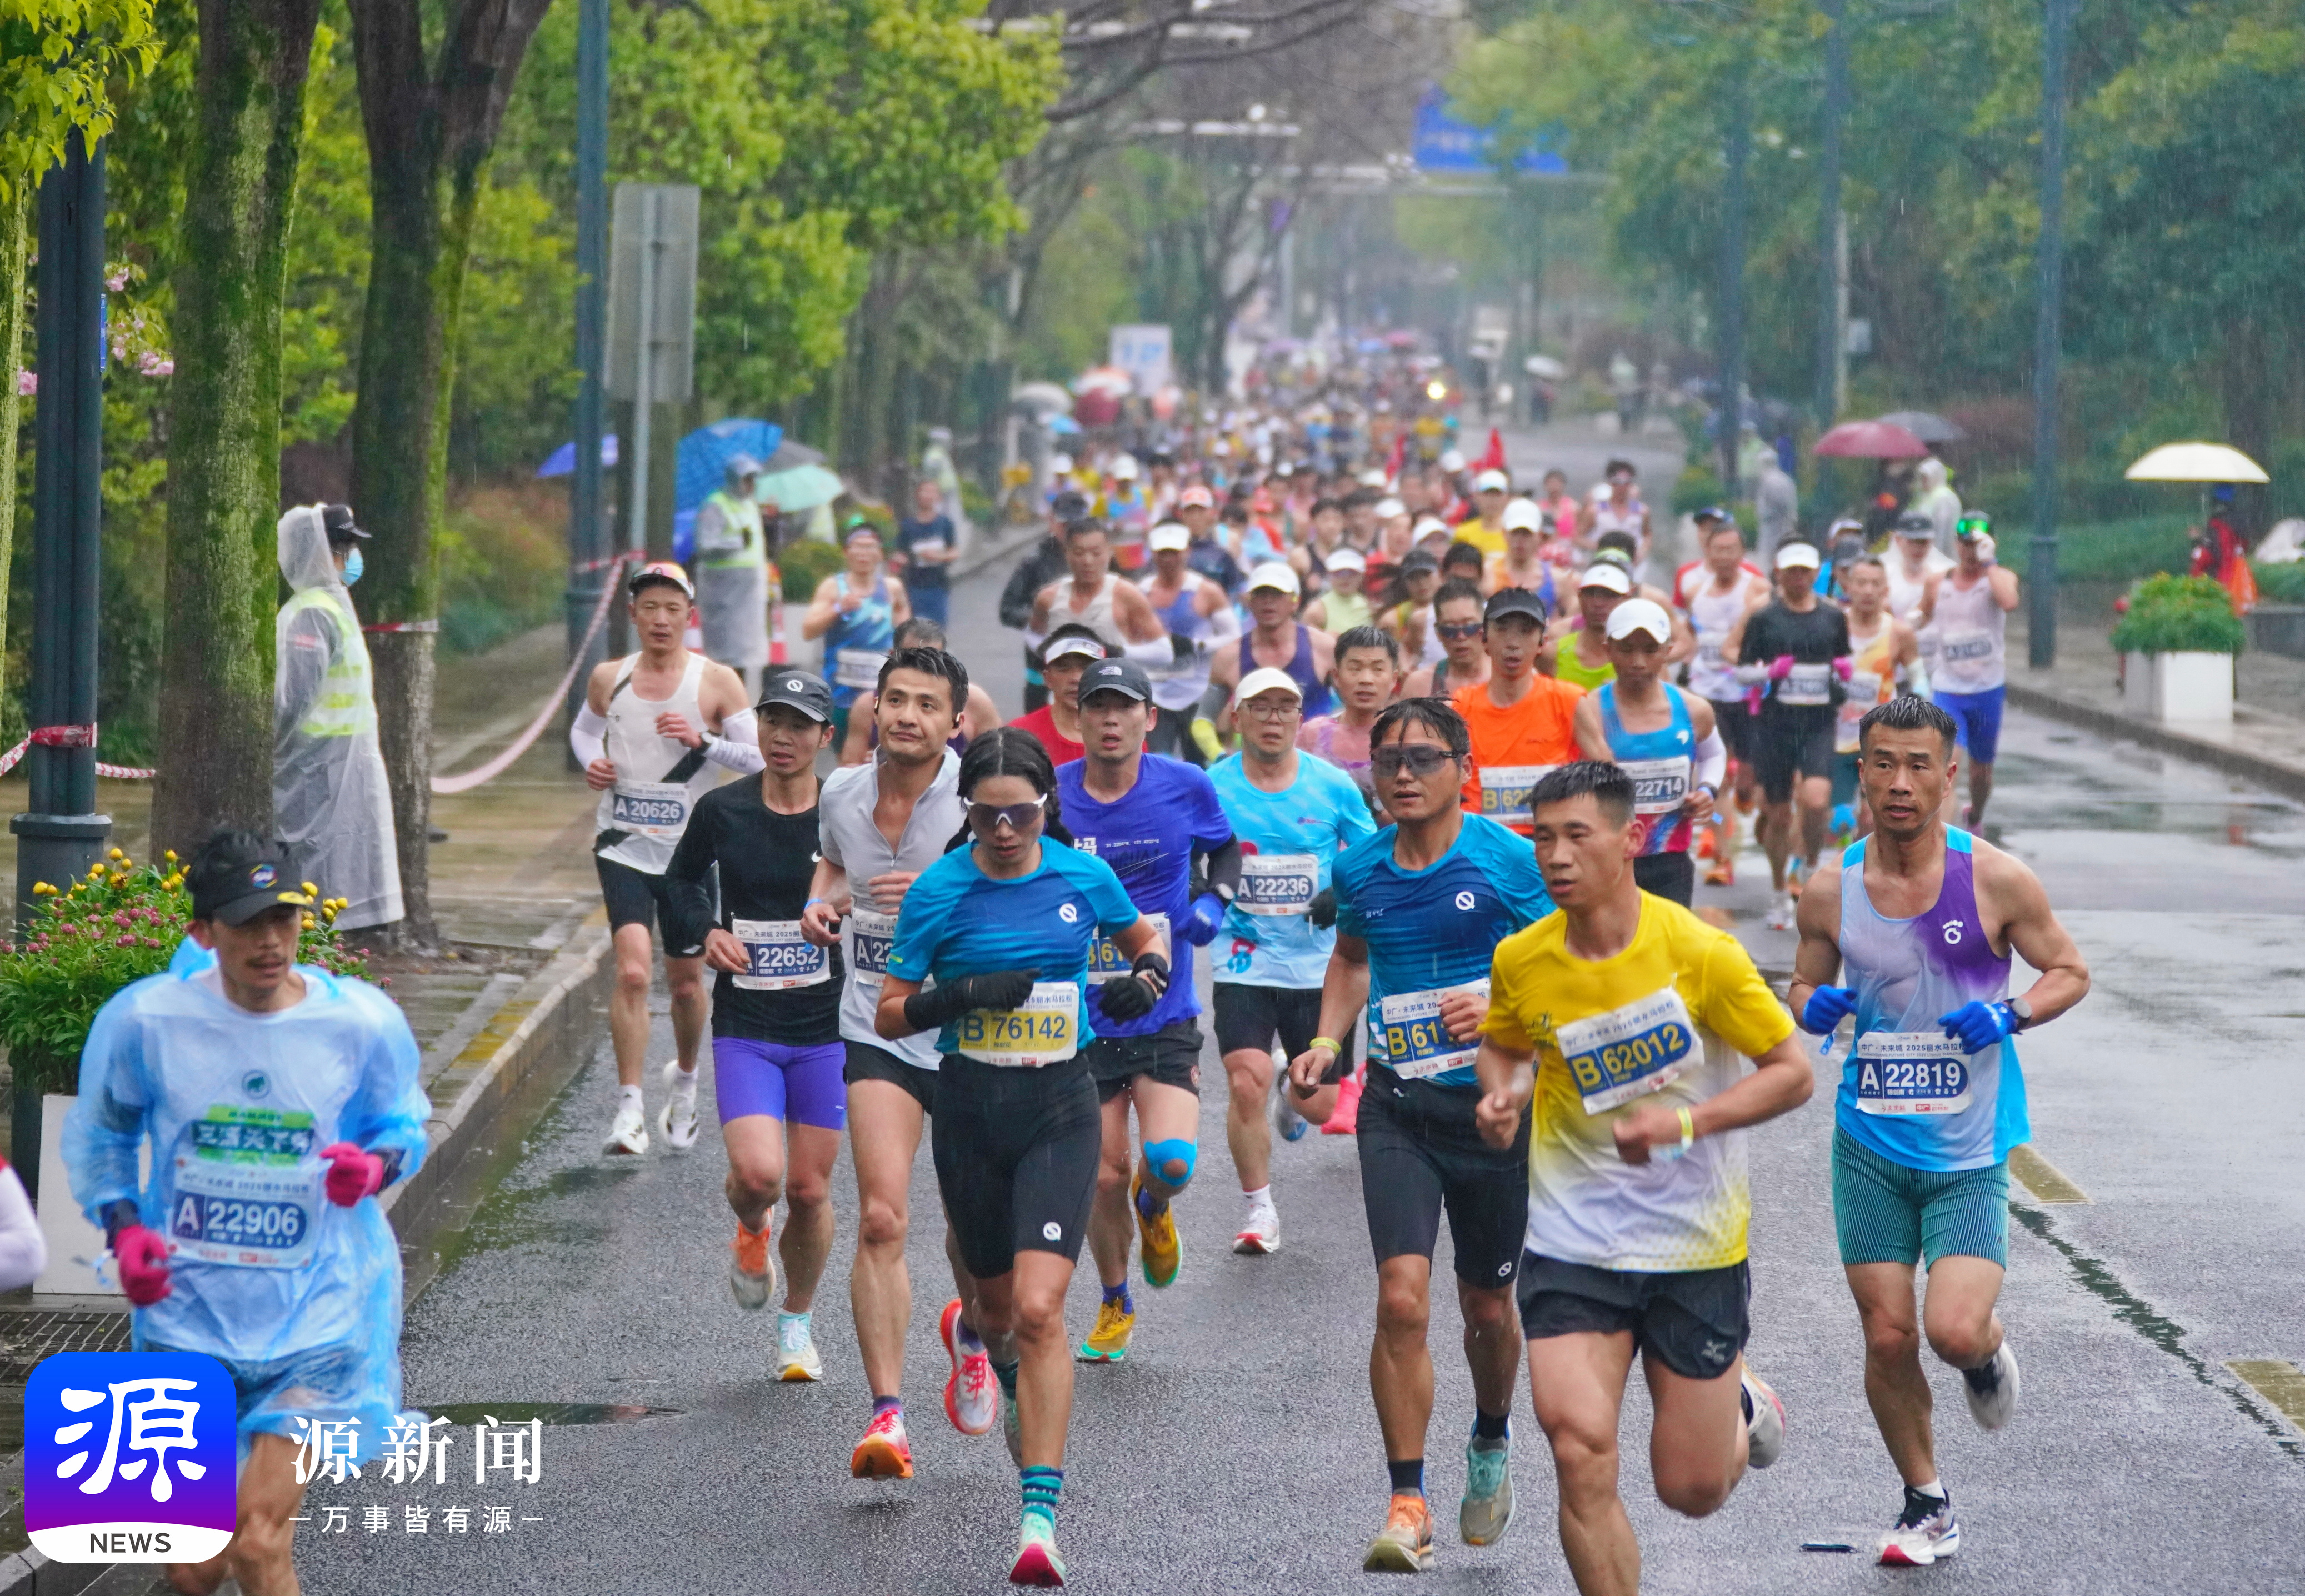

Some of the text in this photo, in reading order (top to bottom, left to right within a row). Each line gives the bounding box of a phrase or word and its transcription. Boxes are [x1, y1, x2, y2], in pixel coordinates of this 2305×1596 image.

[1483, 789, 1533, 809] B 62
[1636, 778, 1681, 797] 22714
[615, 798, 681, 819] A 20626
[1237, 877, 1309, 898] A 22236
[758, 945, 819, 967] 22652
[857, 938, 871, 964] A
[964, 1015, 1066, 1042] B 76142
[1387, 1027, 1407, 1055] B
[1572, 1055, 1601, 1087] B
[1602, 1024, 1684, 1075] 62012
[1861, 1062, 1961, 1090] A 22819
[176, 1197, 299, 1237] A 22906
